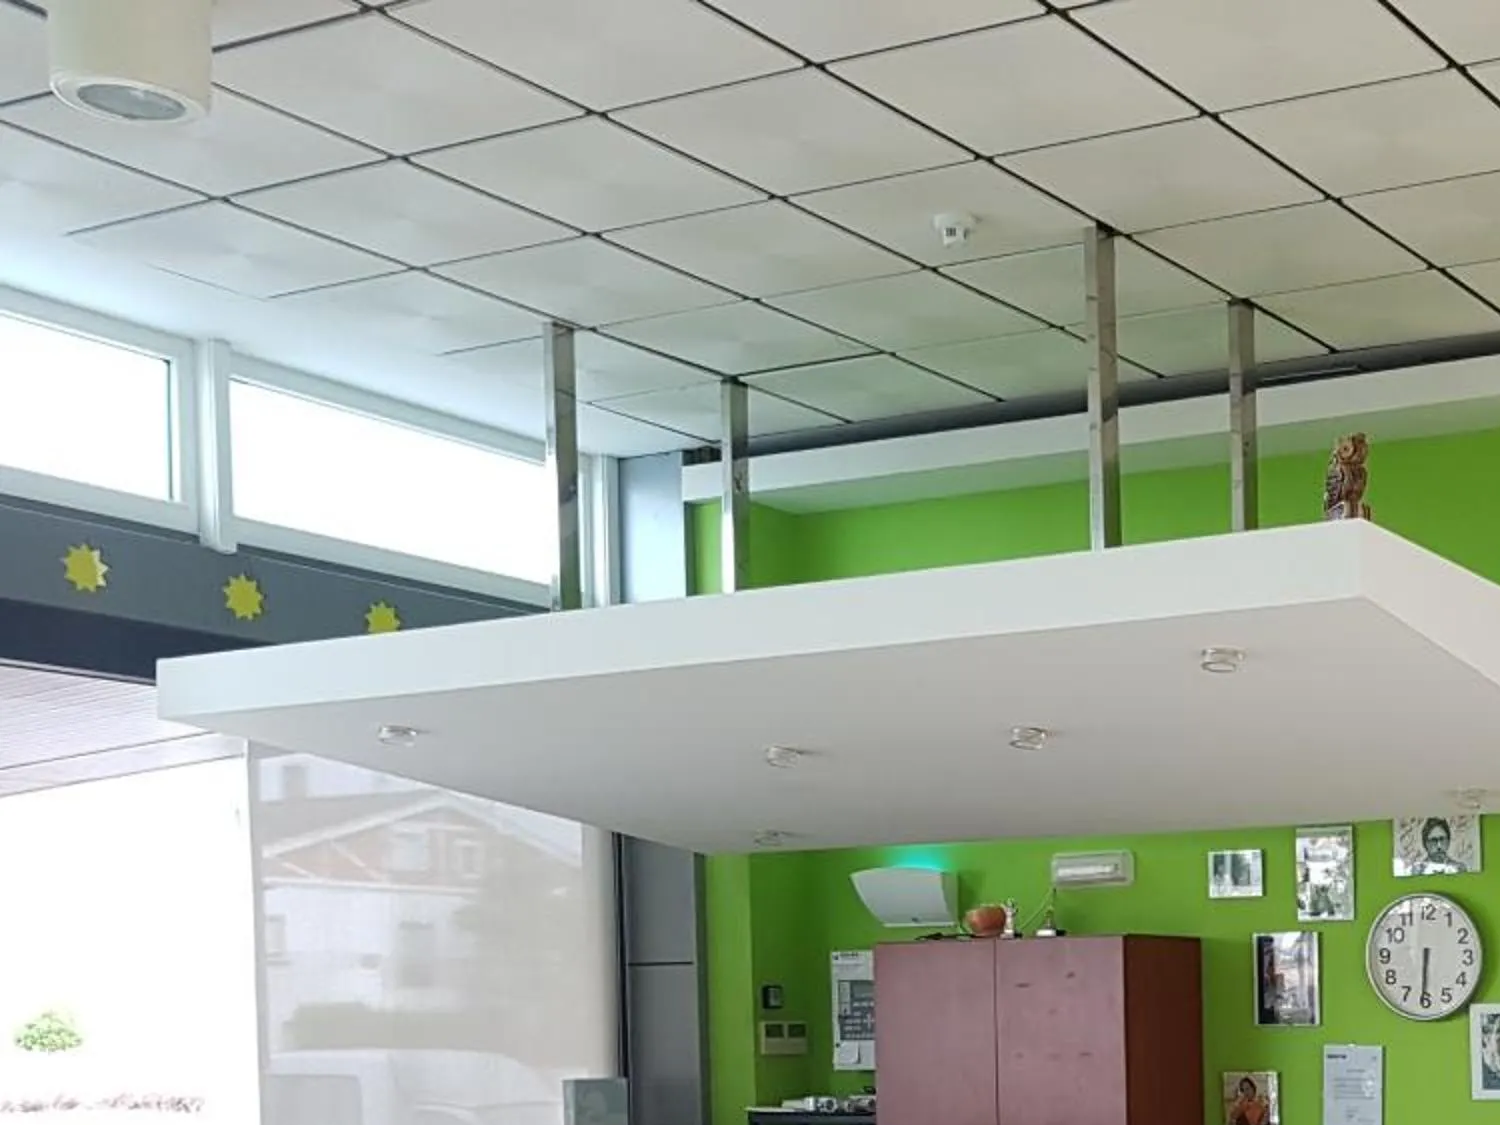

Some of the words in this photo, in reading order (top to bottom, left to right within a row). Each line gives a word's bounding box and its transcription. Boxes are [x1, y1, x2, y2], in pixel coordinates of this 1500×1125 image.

[1400, 911, 1413, 926] 11
[1421, 904, 1436, 920] 12
[1445, 912, 1452, 927] 1
[1386, 927, 1405, 943] 10
[1457, 928, 1469, 944] 2
[1379, 948, 1390, 964] 9
[1463, 949, 1474, 966] 3
[1385, 969, 1397, 985] 8
[1456, 971, 1467, 986] 4
[1401, 986, 1412, 1002] 7
[1420, 992, 1431, 1009] 6
[1441, 988, 1452, 1003] 5
